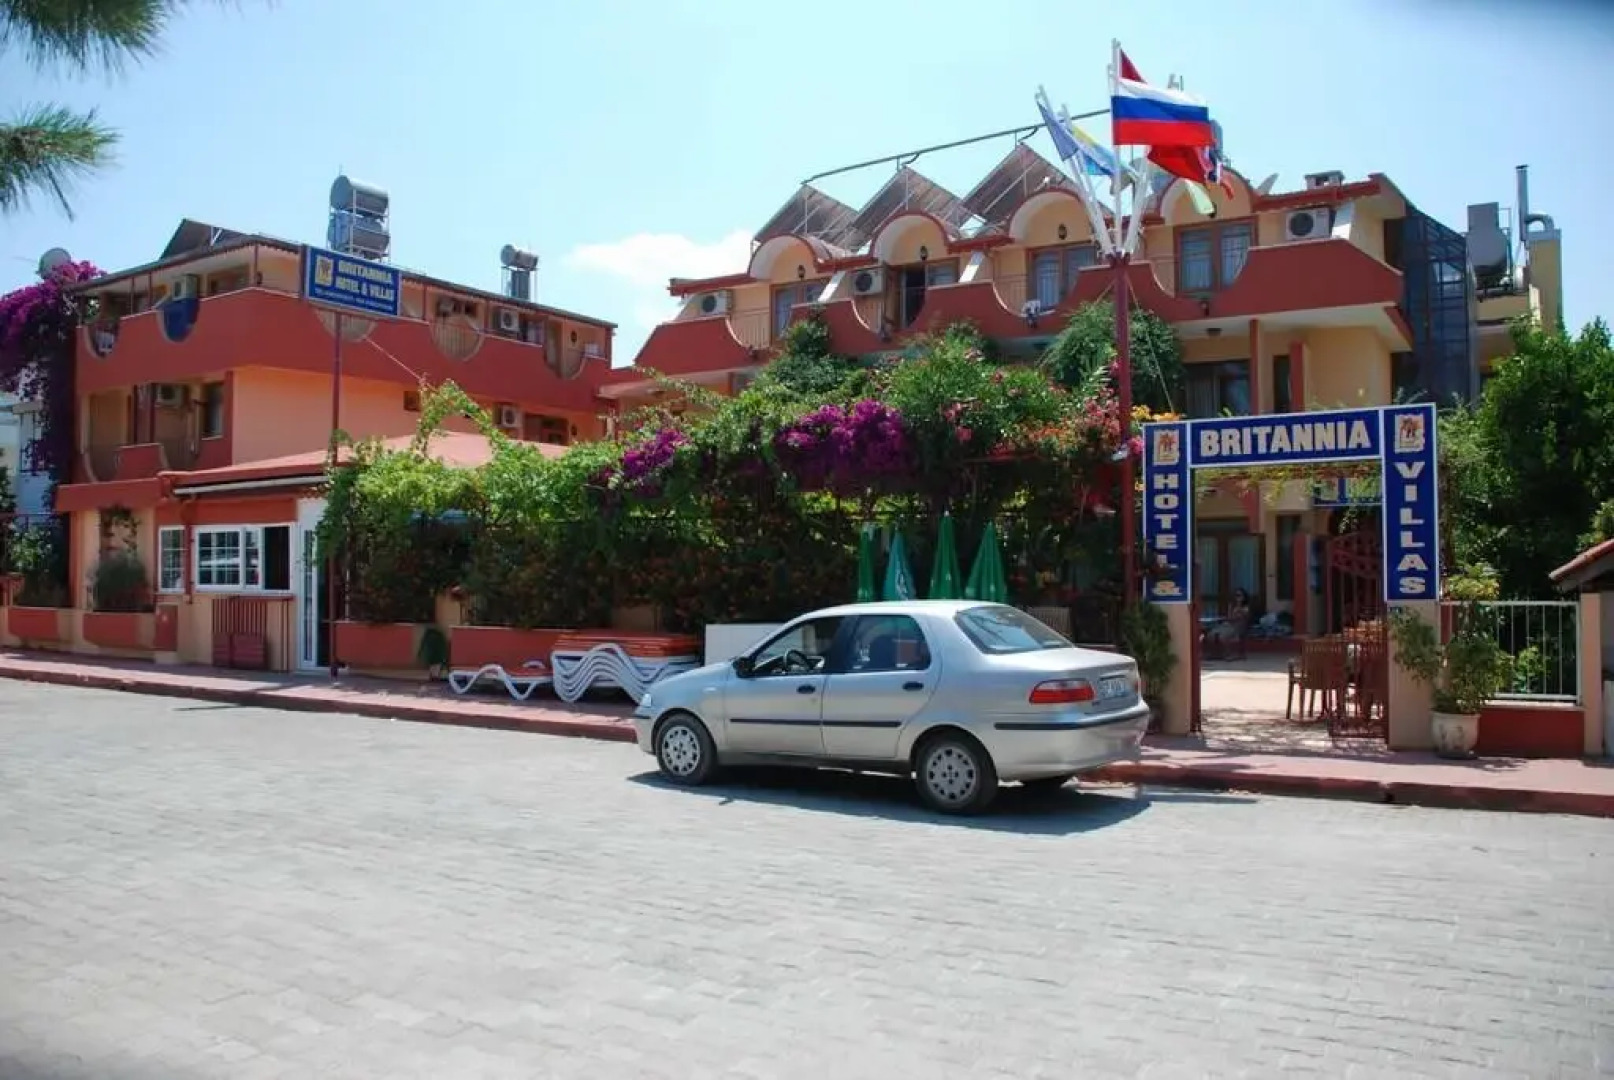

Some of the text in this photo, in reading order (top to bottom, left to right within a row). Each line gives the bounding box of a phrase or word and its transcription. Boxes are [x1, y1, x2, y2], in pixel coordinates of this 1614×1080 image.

[1200, 420, 1371, 457] BRITANNIA
[1152, 473, 1182, 597] HOTEL &
[1395, 461, 1428, 594] VILLAS
